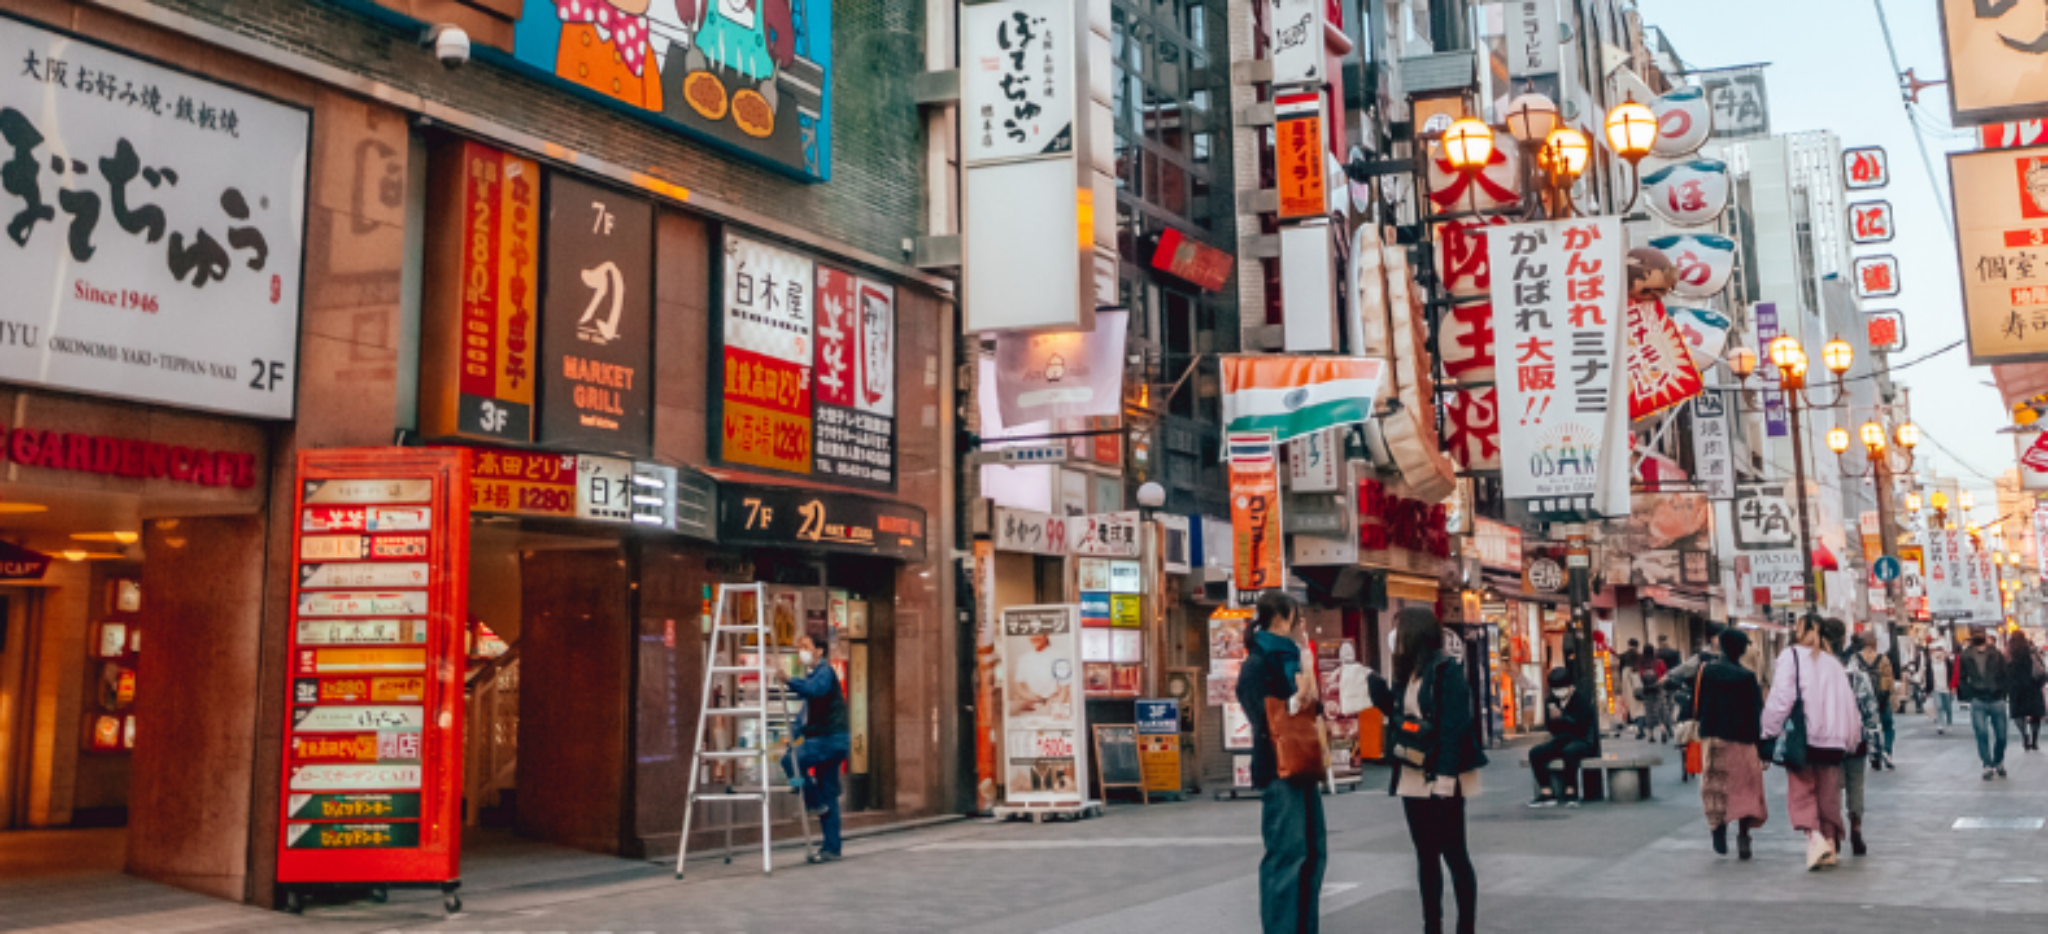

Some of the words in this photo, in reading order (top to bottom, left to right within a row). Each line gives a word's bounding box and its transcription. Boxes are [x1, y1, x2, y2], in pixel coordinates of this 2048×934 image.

[592, 202, 615, 236] 7F
[74, 278, 118, 308] Since
[736, 260, 805, 322] 白木屋
[249, 358, 286, 397] 2F
[563, 354, 635, 391] MARKET
[480, 400, 508, 433] 3F
[572, 384, 625, 416] GRILL
[742, 498, 774, 531] 7F
[1741, 499, 1790, 536] 牛角
